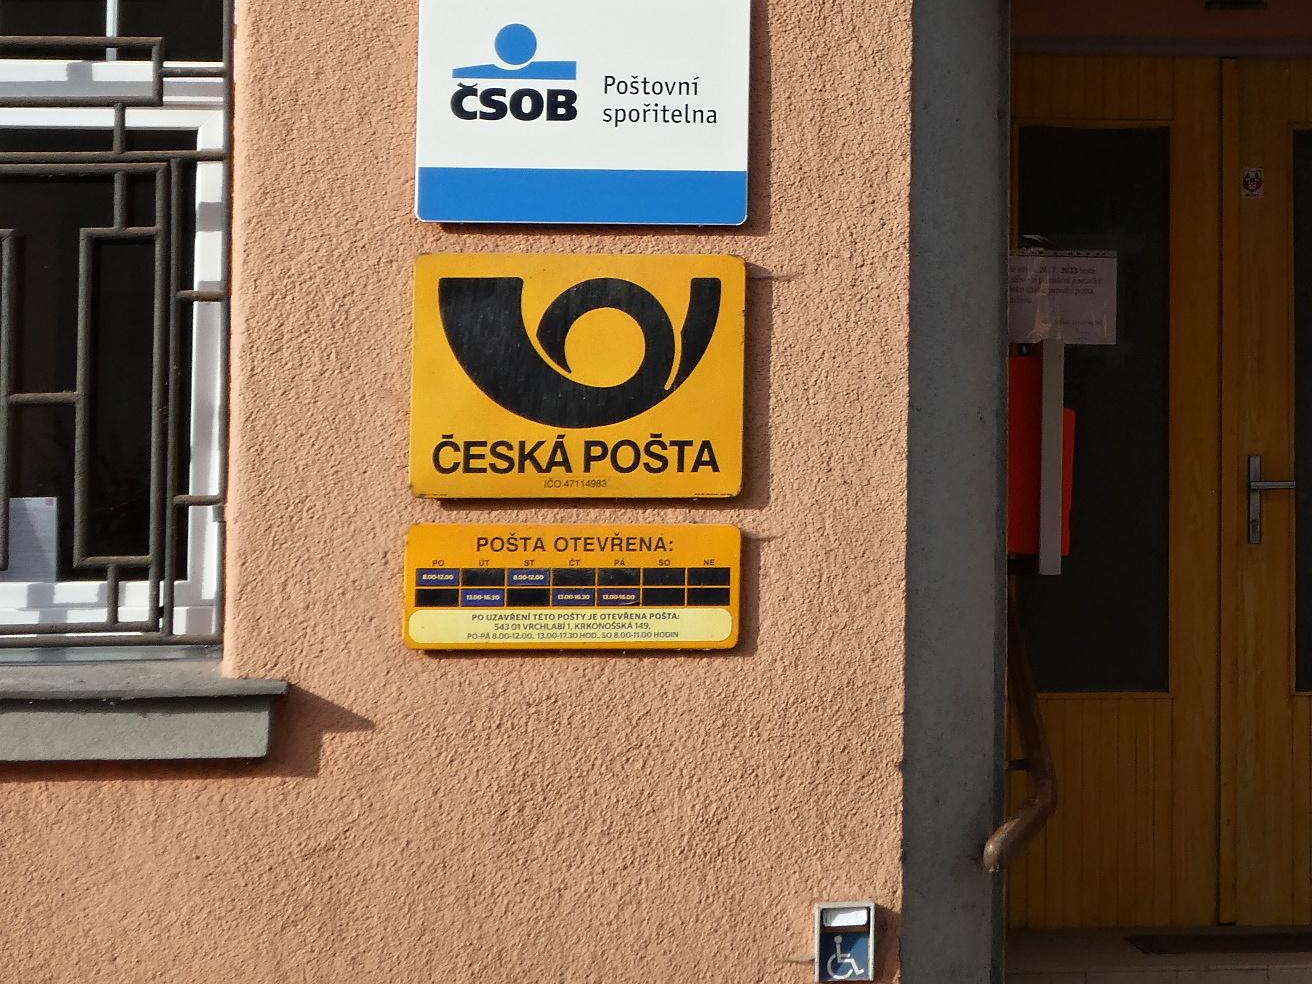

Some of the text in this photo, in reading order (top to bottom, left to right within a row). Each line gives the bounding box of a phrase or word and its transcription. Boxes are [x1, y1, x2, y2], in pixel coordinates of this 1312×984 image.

[603, 75, 700, 97] Poštovní
[449, 81, 578, 122] ČSOB
[602, 102, 718, 128] spořitelna
[432, 433, 721, 474] ČESKÁ POŠTA
[543, 477, 608, 489] IČO 47114983
[476, 532, 673, 552] POŠTA OTEVŘENA:
[432, 559, 445, 567] PO
[523, 559, 535, 567] ST
[568, 557, 580, 566] ČT
[614, 558, 625, 566] PÁ
[703, 558, 715, 566] NE
[471, 611, 680, 621] PO UZAVŘENÍ TÉTO POŠTY JE OTEVŘENA POŠTA:
[494, 623, 510, 631] 543
[511, 623, 521, 631] 01
[523, 622, 565, 631] VRCHLABÍ
[602, 631, 612, 639] SO
